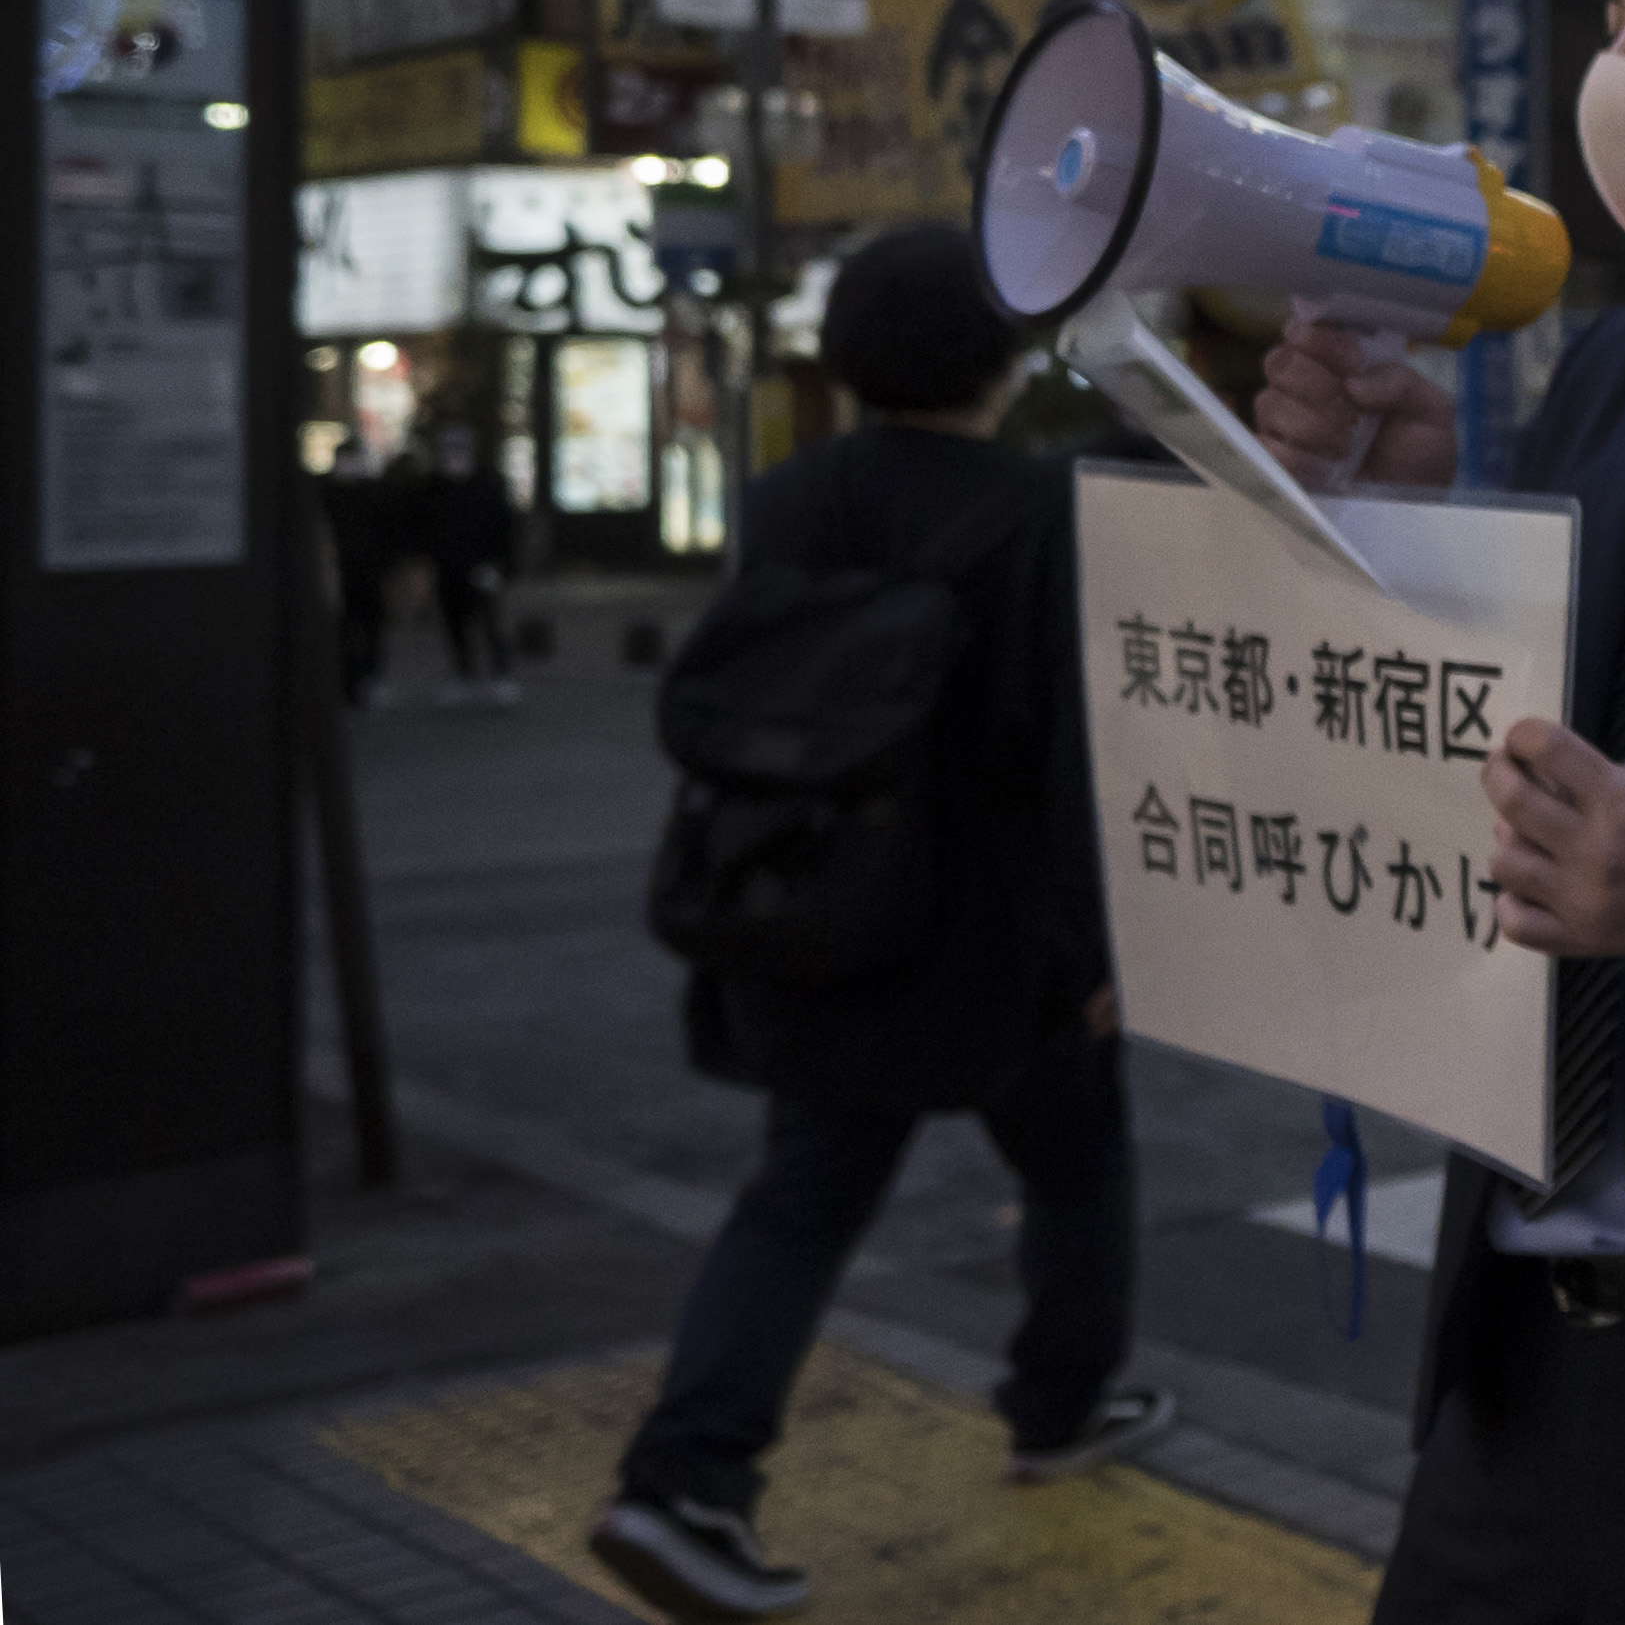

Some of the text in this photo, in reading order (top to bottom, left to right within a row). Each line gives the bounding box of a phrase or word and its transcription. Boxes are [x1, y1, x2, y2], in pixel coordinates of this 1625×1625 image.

[1116, 611, 1503, 763] 東京都・新宿区
[1132, 781, 1504, 952] 合同呼びかけ
